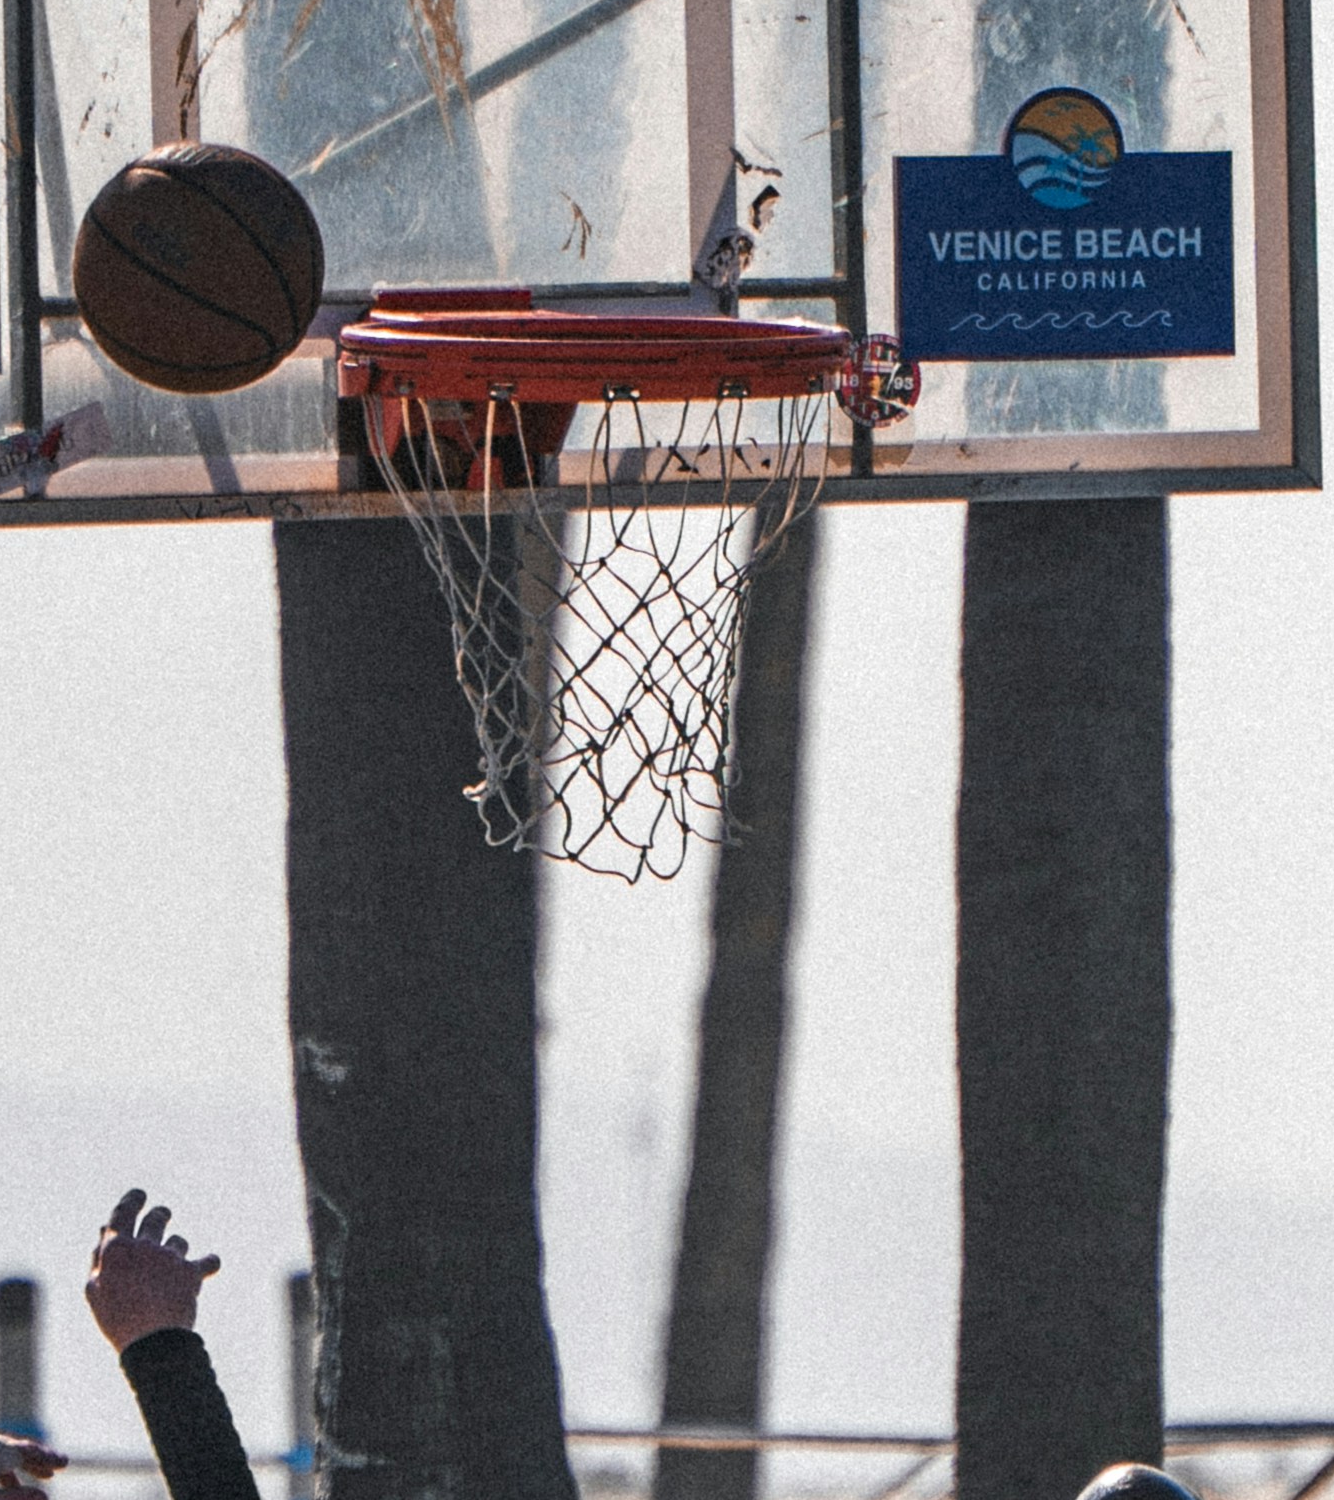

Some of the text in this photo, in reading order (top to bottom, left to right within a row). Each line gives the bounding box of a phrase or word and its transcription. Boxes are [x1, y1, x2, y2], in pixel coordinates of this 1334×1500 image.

[929, 228, 1203, 261] VENICE BEACH
[977, 271, 1147, 291] CALIFORNIA
